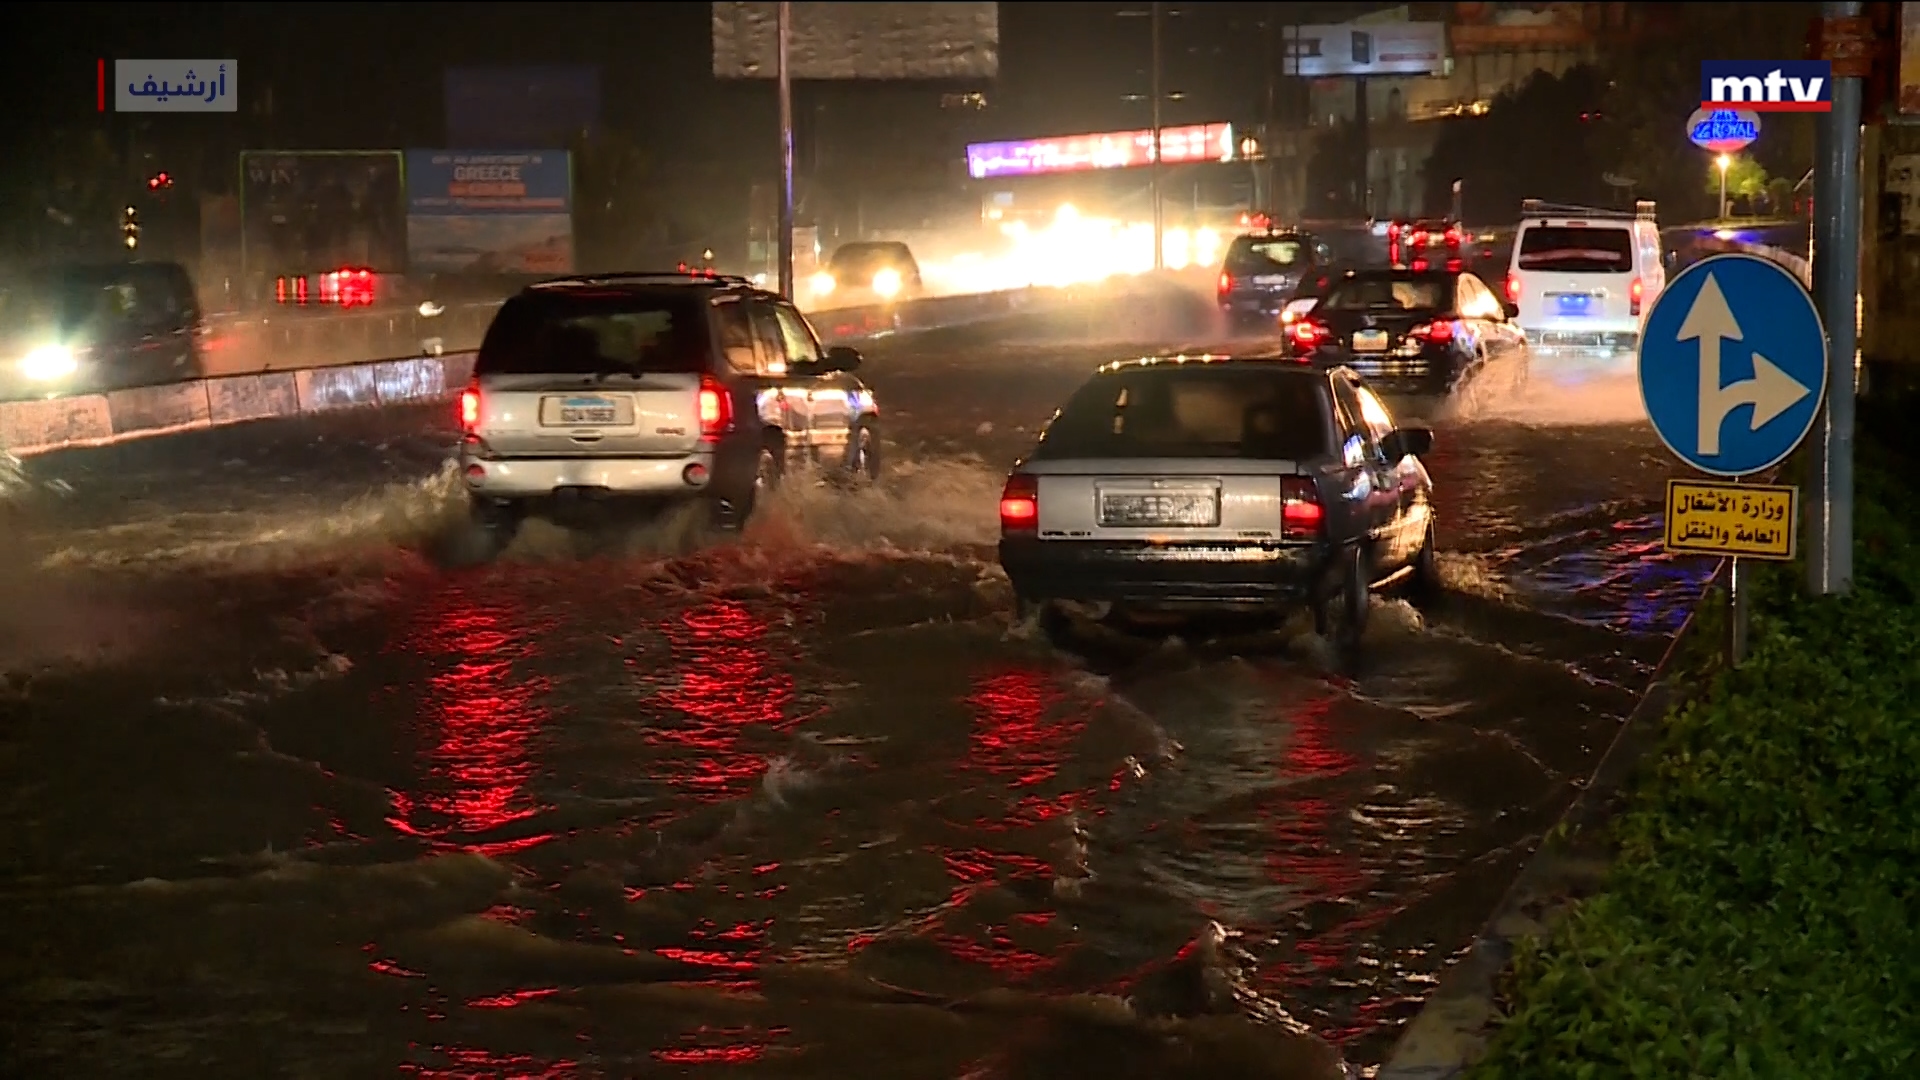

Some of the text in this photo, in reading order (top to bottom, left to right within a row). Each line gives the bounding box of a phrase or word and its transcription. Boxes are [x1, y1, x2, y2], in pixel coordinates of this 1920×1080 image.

[1712, 122, 1756, 139] ROYAL
[454, 165, 522, 181] GREECE
[1677, 491, 1784, 520] وزارة الأشغال
[1677, 521, 1780, 545] العامة والنقل
